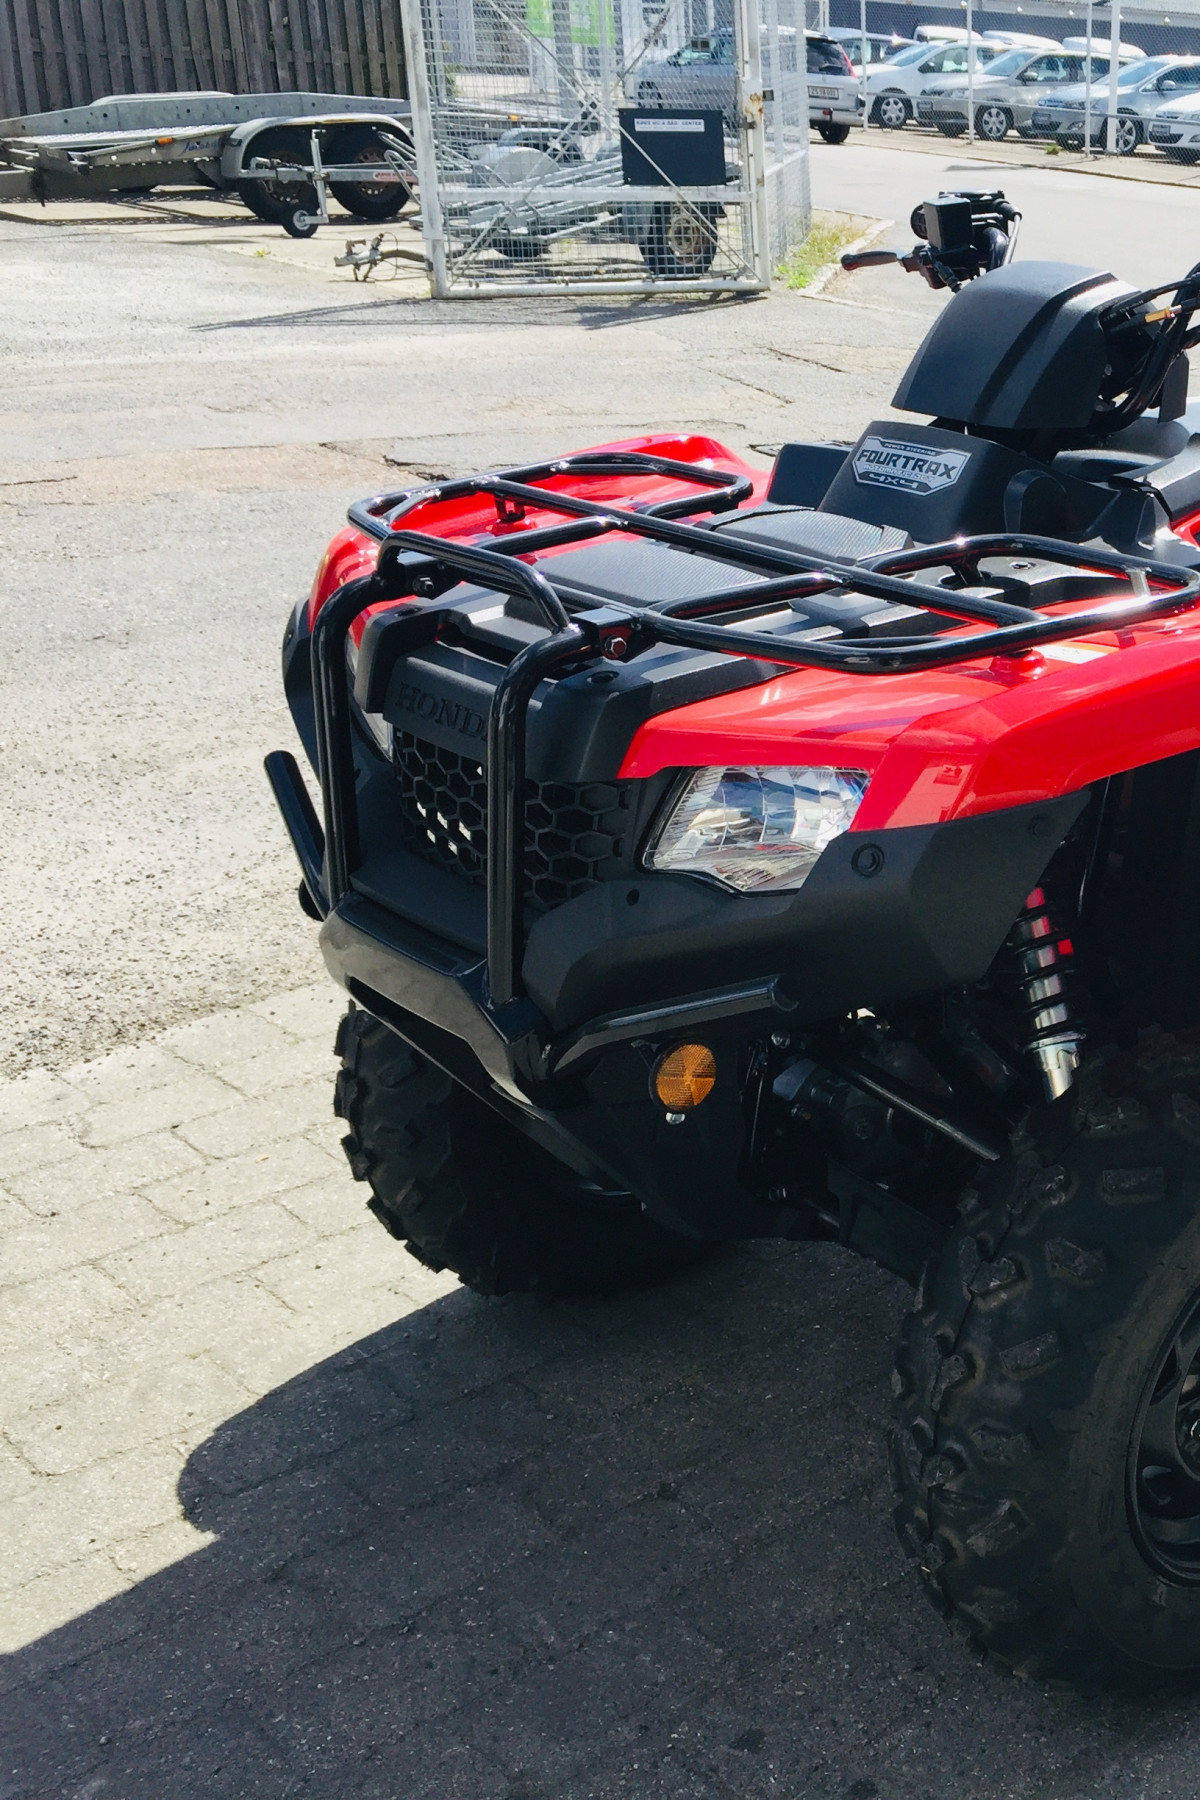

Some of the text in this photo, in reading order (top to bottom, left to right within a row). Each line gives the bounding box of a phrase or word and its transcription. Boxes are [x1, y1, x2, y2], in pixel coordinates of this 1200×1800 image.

[884, 442, 936, 457] POWER STEERING
[857, 449, 958, 479] FOURTRAX
